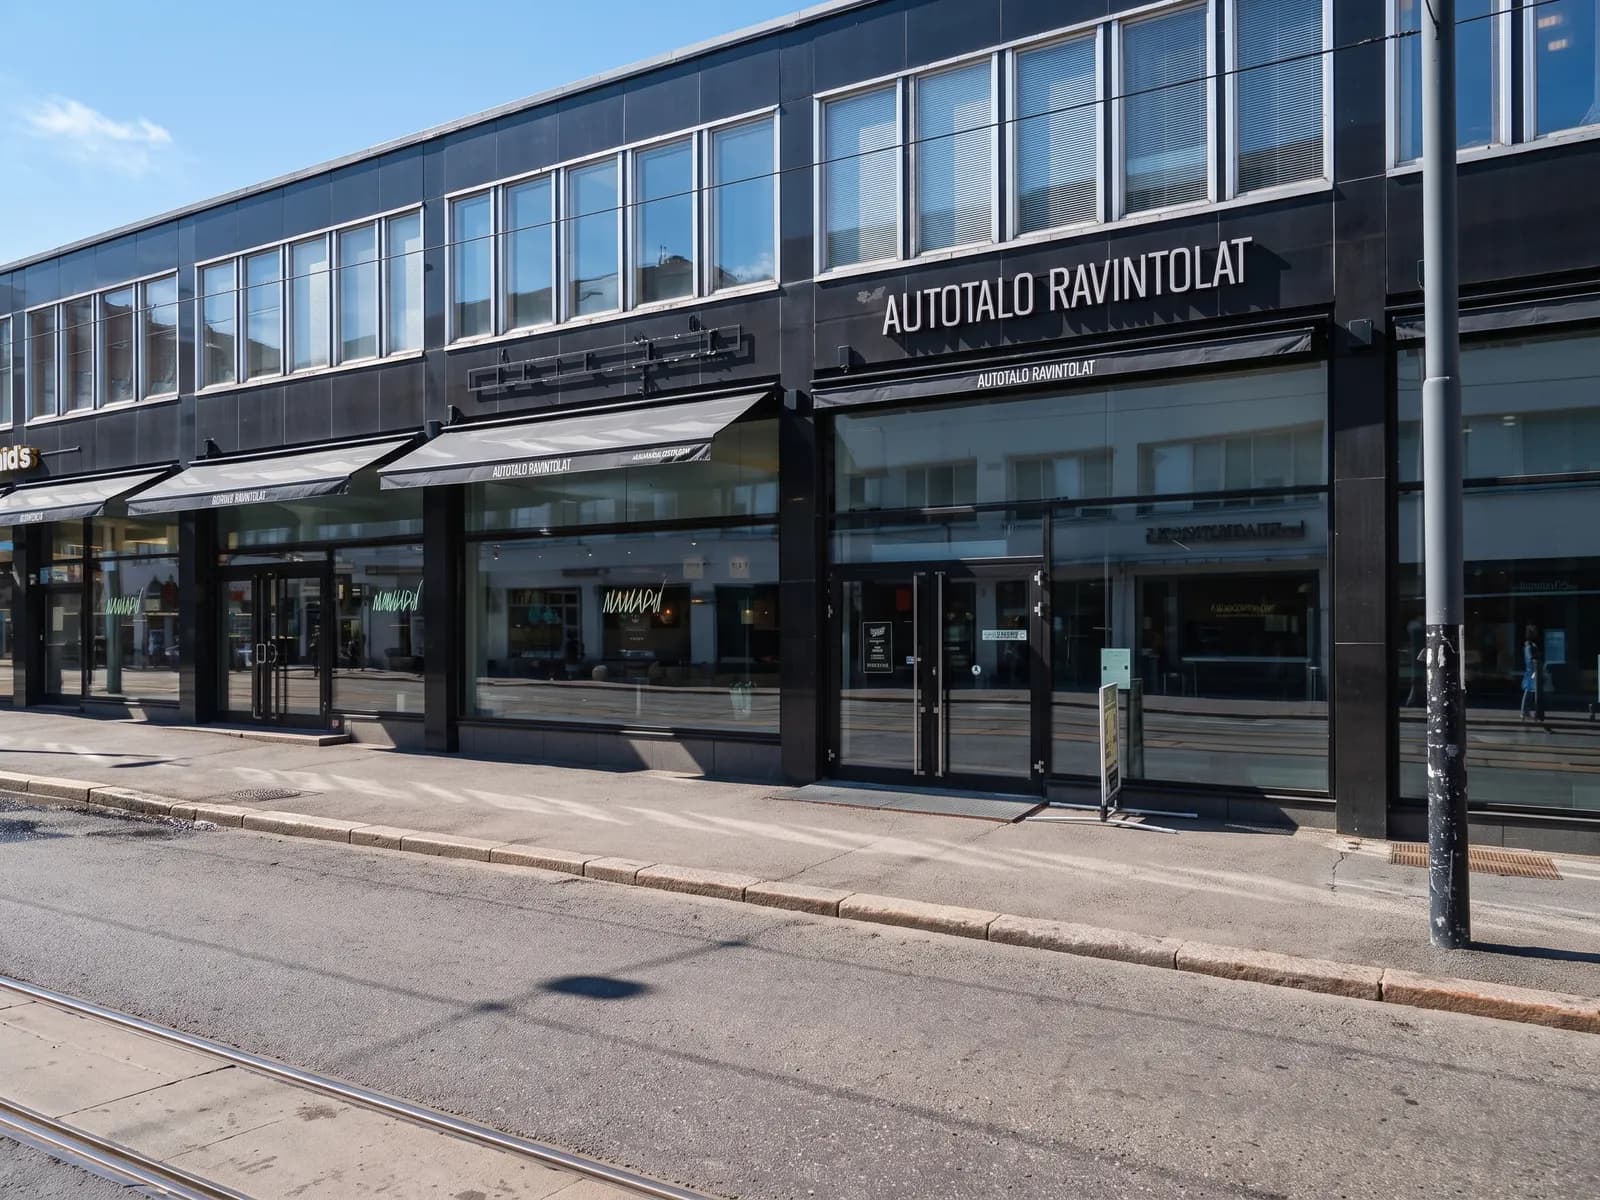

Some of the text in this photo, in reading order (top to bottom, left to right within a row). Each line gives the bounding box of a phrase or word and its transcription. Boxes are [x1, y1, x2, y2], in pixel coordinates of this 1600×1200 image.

[882, 236, 1253, 336] AUTOTALO RAVINTOLAT
[977, 359, 1096, 389] AUTOTALO RAVINTOLAT
[492, 458, 572, 478] AUTOTALO RAVINTOLAT
